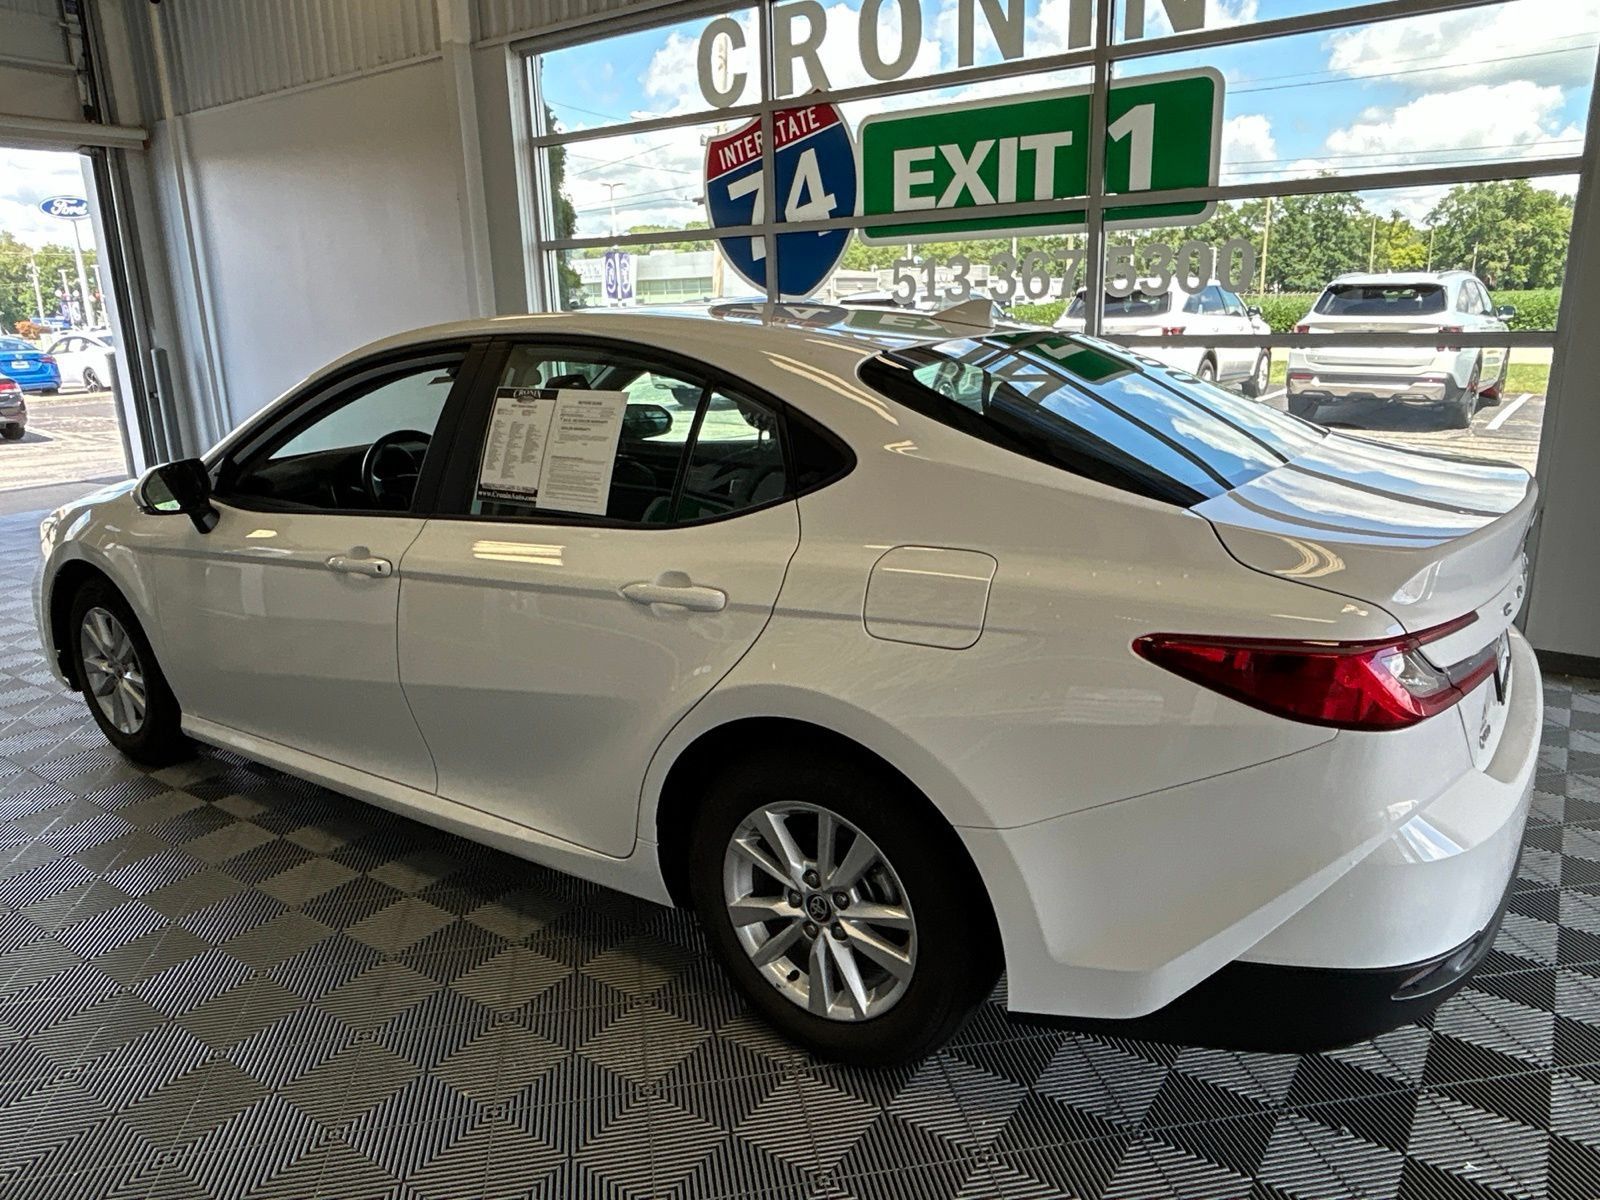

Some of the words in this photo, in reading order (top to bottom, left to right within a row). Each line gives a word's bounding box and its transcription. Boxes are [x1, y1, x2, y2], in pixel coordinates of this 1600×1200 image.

[718, 106, 820, 170] INTERTATE
[893, 131, 1073, 211] EXIT
[1107, 103, 1155, 191] 1
[50, 199, 88, 216] Ford
[727, 148, 837, 261] 74
